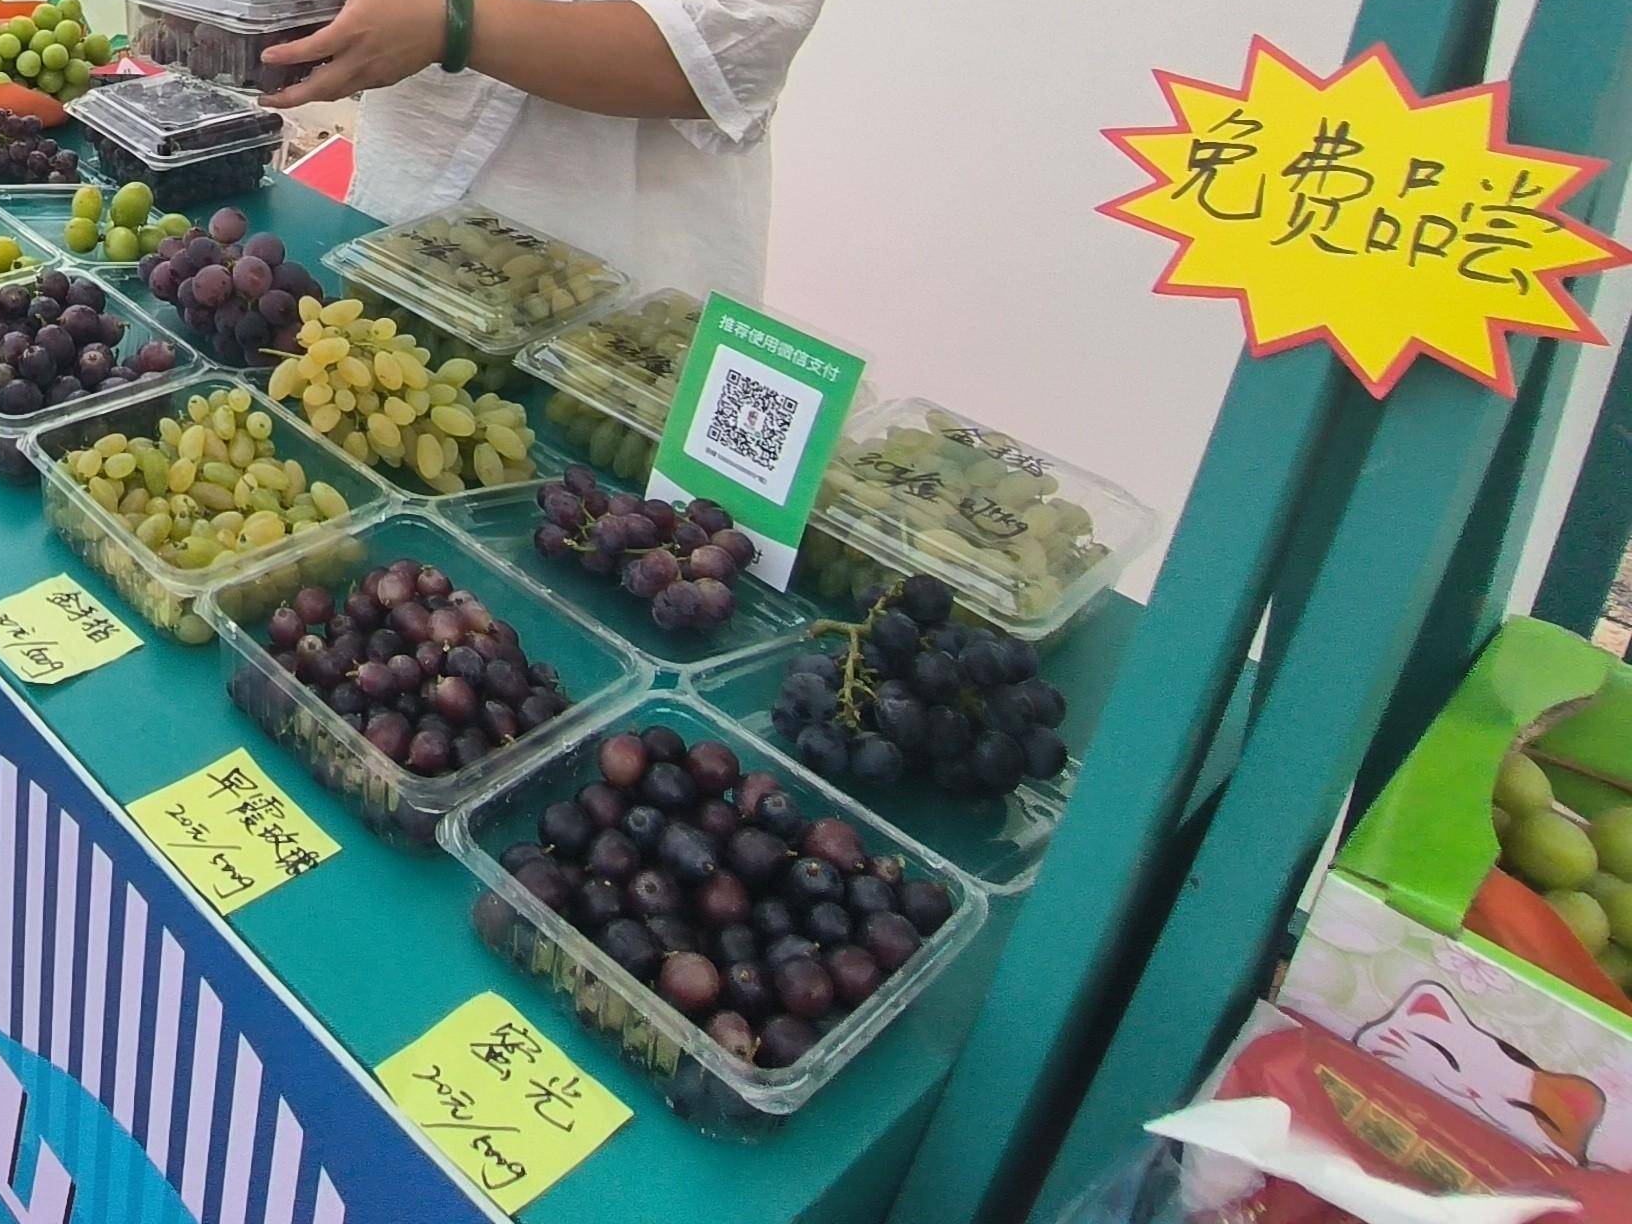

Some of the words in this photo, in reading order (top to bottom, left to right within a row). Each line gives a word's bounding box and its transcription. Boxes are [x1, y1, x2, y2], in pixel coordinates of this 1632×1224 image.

[1170, 109, 1563, 296] 免费品尝
[718, 314, 841, 383] 推荐使用微信支付
